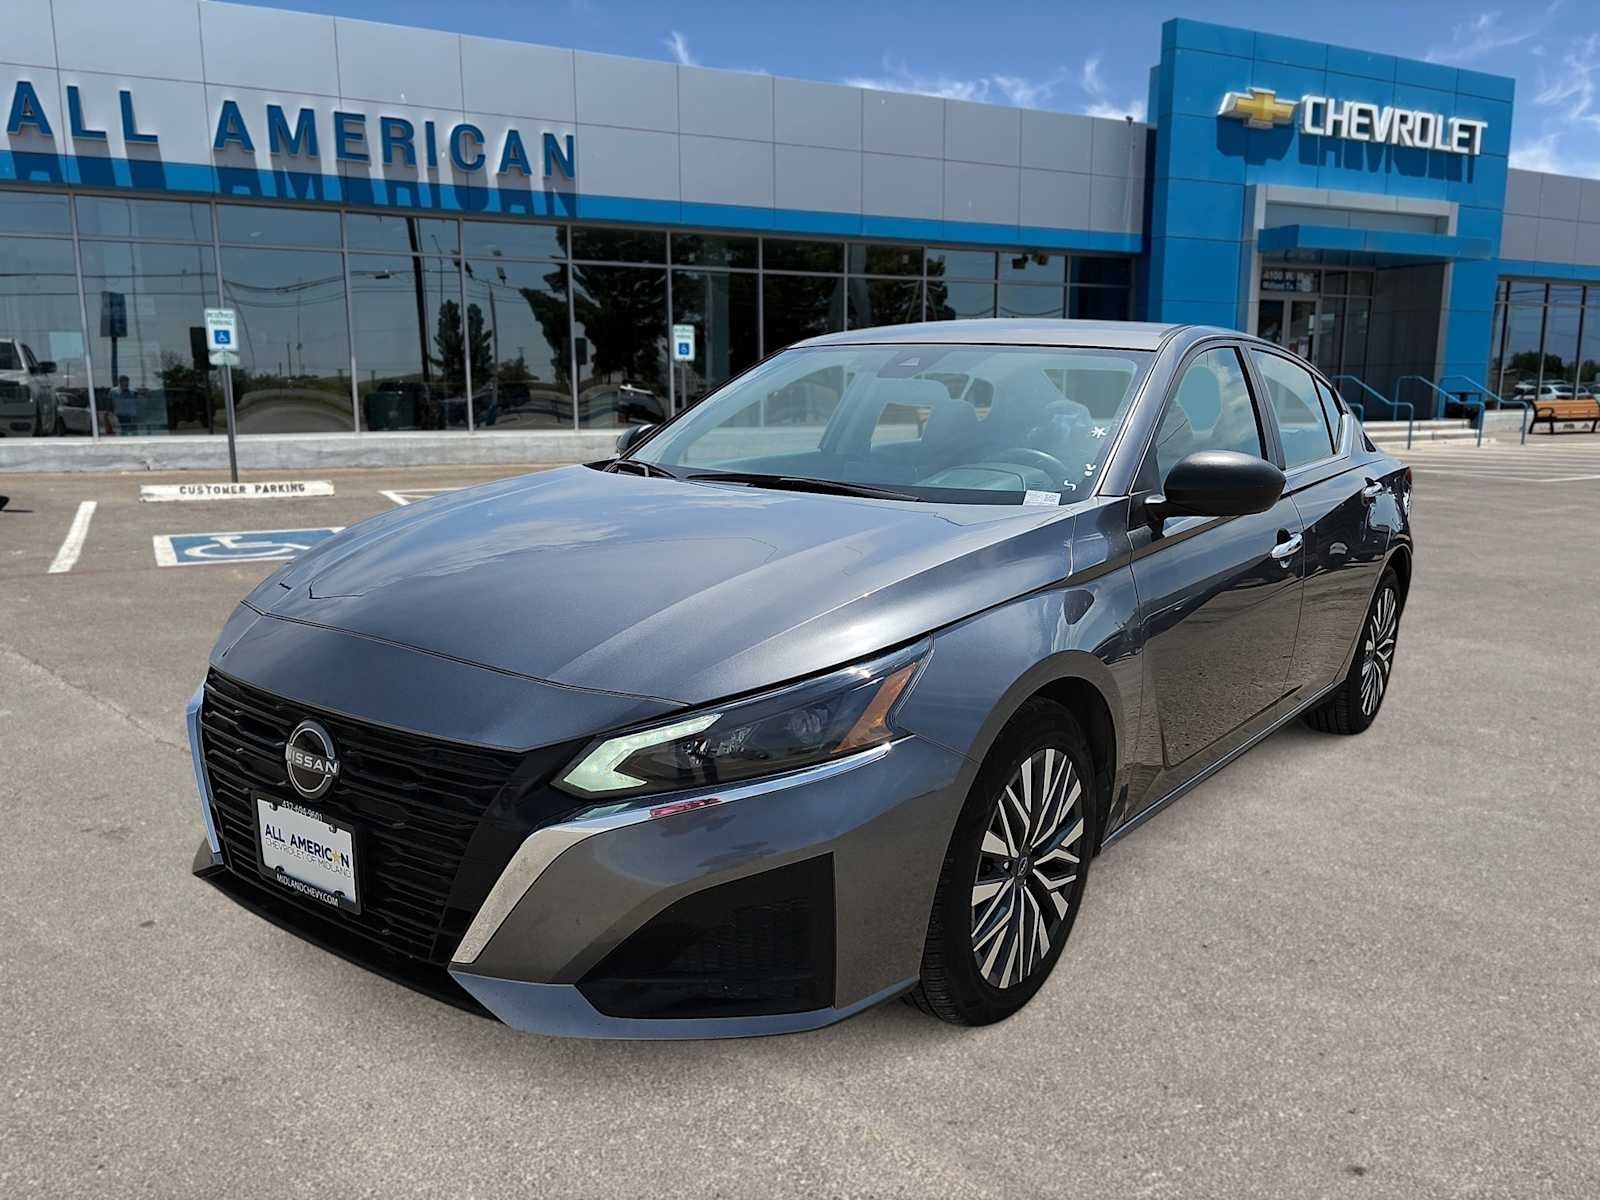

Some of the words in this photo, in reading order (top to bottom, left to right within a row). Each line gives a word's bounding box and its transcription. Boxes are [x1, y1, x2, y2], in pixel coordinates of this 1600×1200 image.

[6, 80, 158, 143] ALL
[213, 99, 576, 178] AMERICAN
[1301, 94, 1489, 155] CHEVROLET
[179, 485, 246, 495] CUSTOMER
[254, 483, 305, 493] PARKING
[287, 748, 338, 774] NISSAN
[265, 823, 286, 843] ALL
[290, 833, 350, 868] AMERICN
